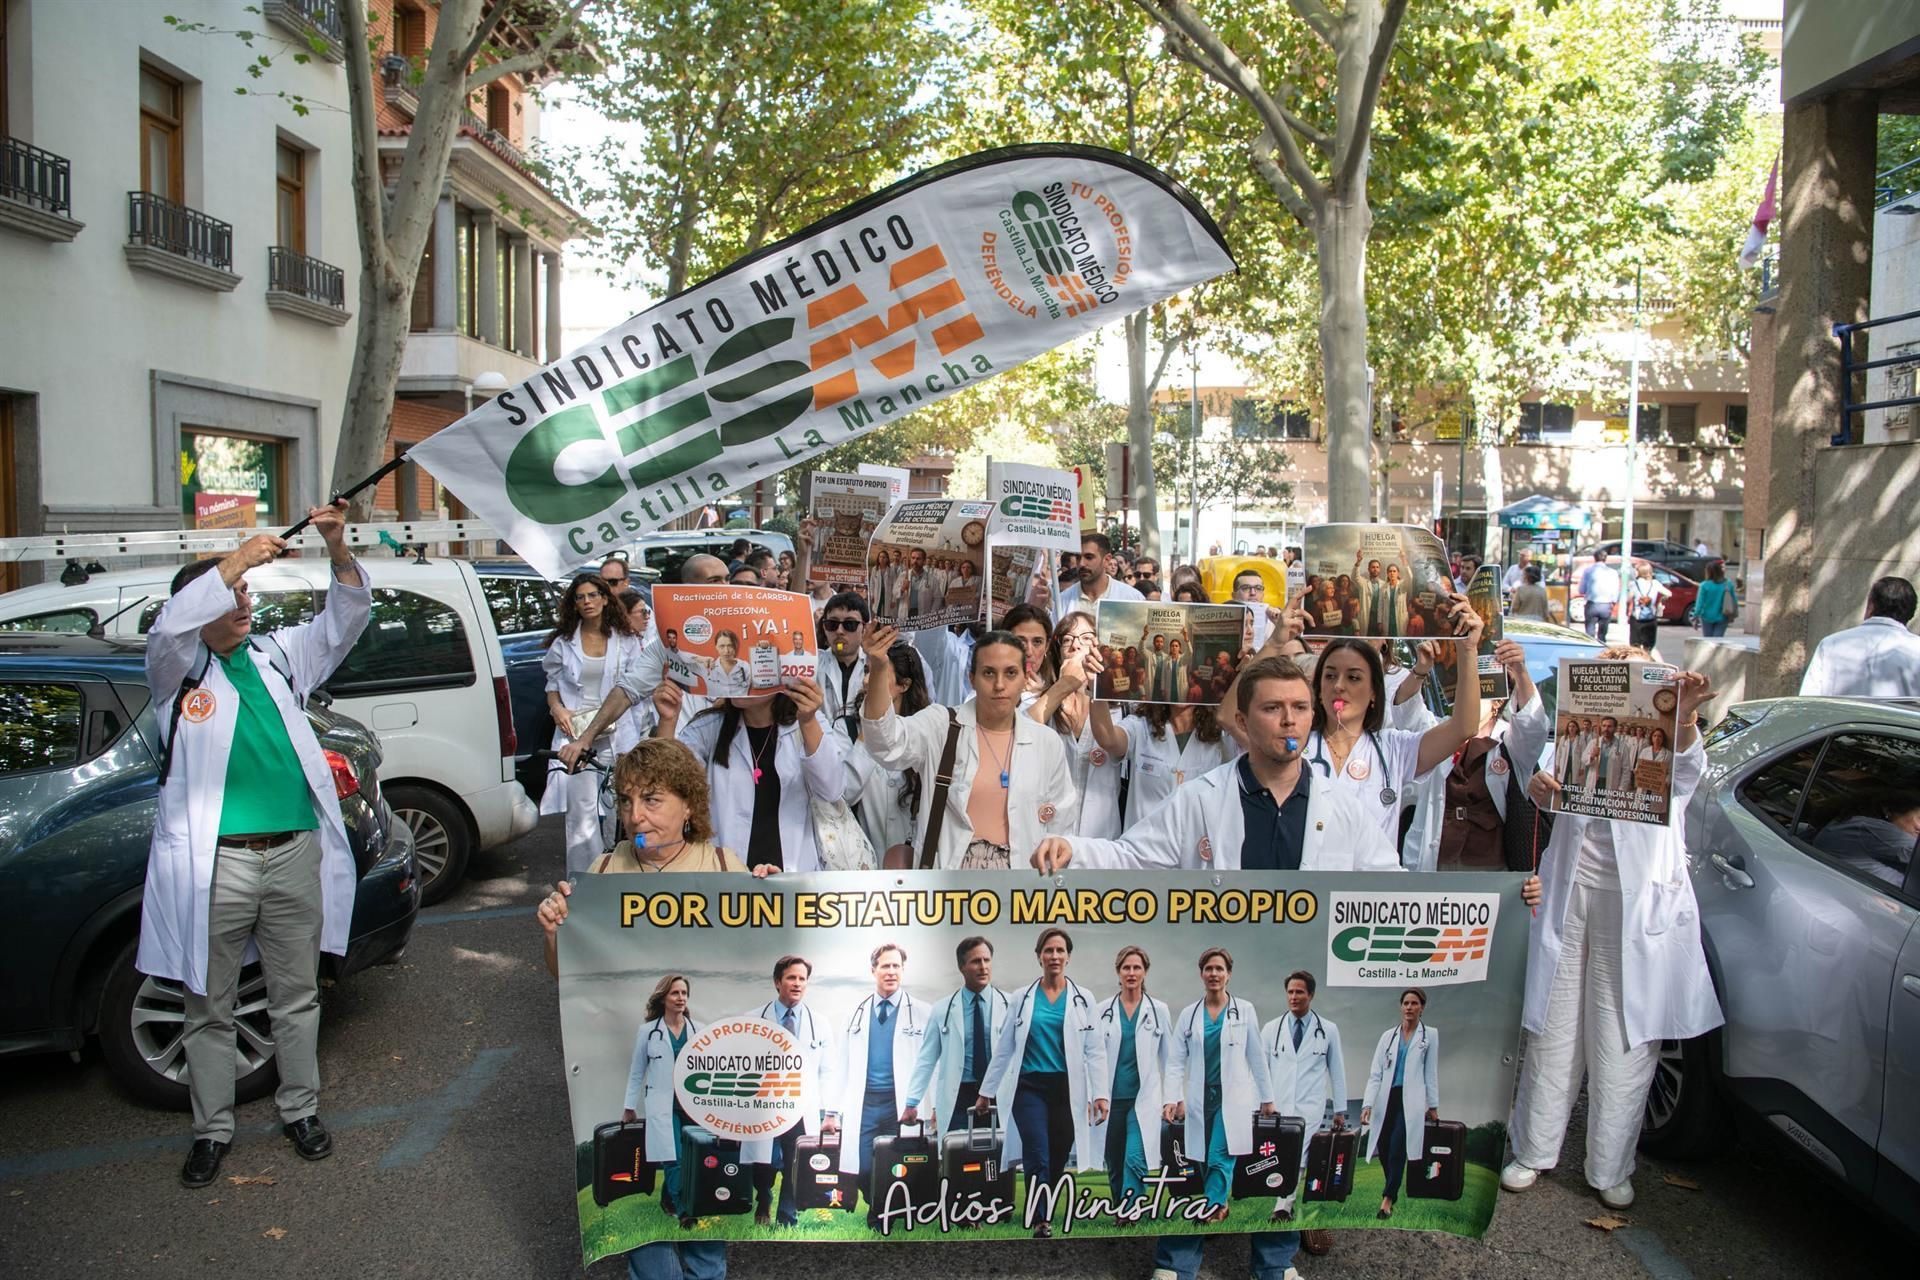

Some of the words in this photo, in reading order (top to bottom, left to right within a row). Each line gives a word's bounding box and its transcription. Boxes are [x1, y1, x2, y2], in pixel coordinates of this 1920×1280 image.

[1043, 182, 1090, 255] SINDICATO
[1076, 255, 1119, 304] MÉDICO
[1071, 181, 1094, 200] TU
[1094, 194, 1132, 285] PROFESIÓN
[1012, 191, 1098, 318] CESM
[981, 232, 1038, 319] DEFIÉNDELA
[1030, 274, 1061, 320] Mancha
[497, 297, 735, 426] SINDICATO
[750, 214, 914, 315] MÉDICO
[505, 243, 985, 525] CESM
[568, 471, 730, 556] Castilla
[774, 428, 825, 458] La
[838, 353, 994, 432] Mancha
[836, 478, 864, 487] ESTATUTO
[864, 480, 887, 488] PROPIO
[1003, 480, 1045, 497] SINDICATO
[1046, 483, 1071, 502] MÉDICO
[199, 506, 209, 516] Tu
[1001, 495, 1072, 524] CESM
[1048, 528, 1070, 538] Mancha
[673, 592, 728, 602] Reactivación
[756, 592, 794, 602] CARRERA
[704, 606, 770, 616] PROFESIONAL
[1195, 612, 1234, 620] HOSPITAL
[670, 660, 690, 678] 2012
[782, 665, 814, 678] 2025
[1572, 666, 1599, 675] HUELGA
[1601, 664, 1628, 675] MÉDICA
[1580, 675, 1628, 684] FACULTATIVA
[1604, 701, 1624, 709] dignidad
[1570, 795, 1624, 808] REACTIVACIÓN
[1628, 802, 1638, 810] YA
[1639, 803, 1650, 812] DE
[1598, 790, 1625, 799] MANCHA
[1635, 793, 1662, 803] LEVANTA
[1560, 802, 1570, 810] LA
[1571, 804, 1606, 817] CARRERA
[1607, 806, 1663, 824] PROFESIONAL.
[621, 892, 713, 928] POR
[718, 892, 784, 928] UN
[794, 889, 1000, 928] ESTATUTO
[1011, 888, 1158, 925] MARCO
[1167, 888, 1318, 924] PROPIO
[1334, 901, 1421, 925] SINDICATO
[1426, 896, 1490, 926] MÉDICO
[1332, 926, 1488, 963] CESM
[1358, 967, 1396, 978] Castilla
[1406, 968, 1418, 978] La
[1421, 968, 1458, 978] Mancha
[692, 1034, 712, 1053] TU
[712, 1022, 792, 1052] PROFESIÓN
[687, 1054, 752, 1071] SINDICATO
[755, 1050, 802, 1071] MÉDICO
[684, 1072, 801, 1097] CESM
[693, 1096, 750, 1108] Castilla-La
[754, 1100, 795, 1109] Mancha
[704, 1113, 786, 1134] DEFIÉNDELA
[878, 1177, 1014, 1234] Adiós
[1023, 1164, 1220, 1233] Ministra
